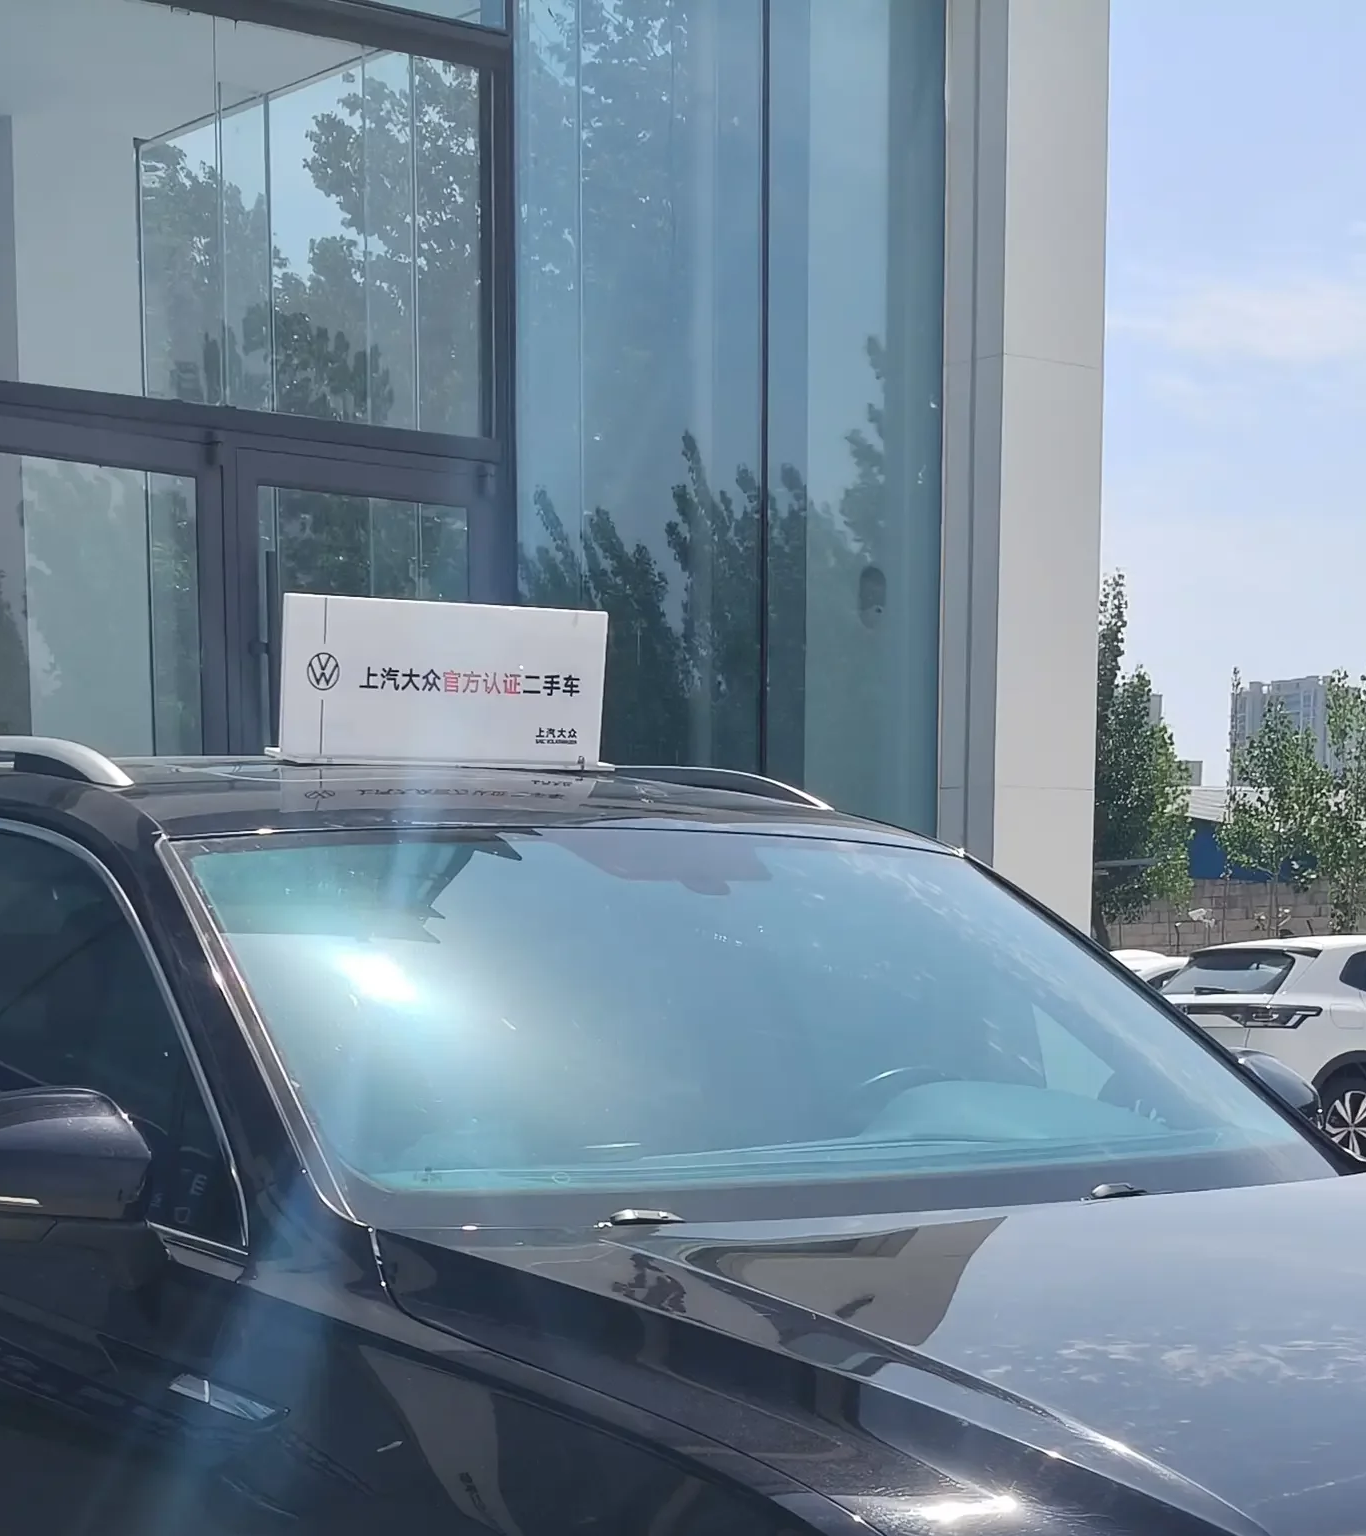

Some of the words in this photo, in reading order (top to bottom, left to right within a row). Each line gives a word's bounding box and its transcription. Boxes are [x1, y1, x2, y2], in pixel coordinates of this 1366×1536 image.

[358, 666, 582, 698] 上汽大众官方认证二手车
[535, 727, 578, 739] 上汽大众
